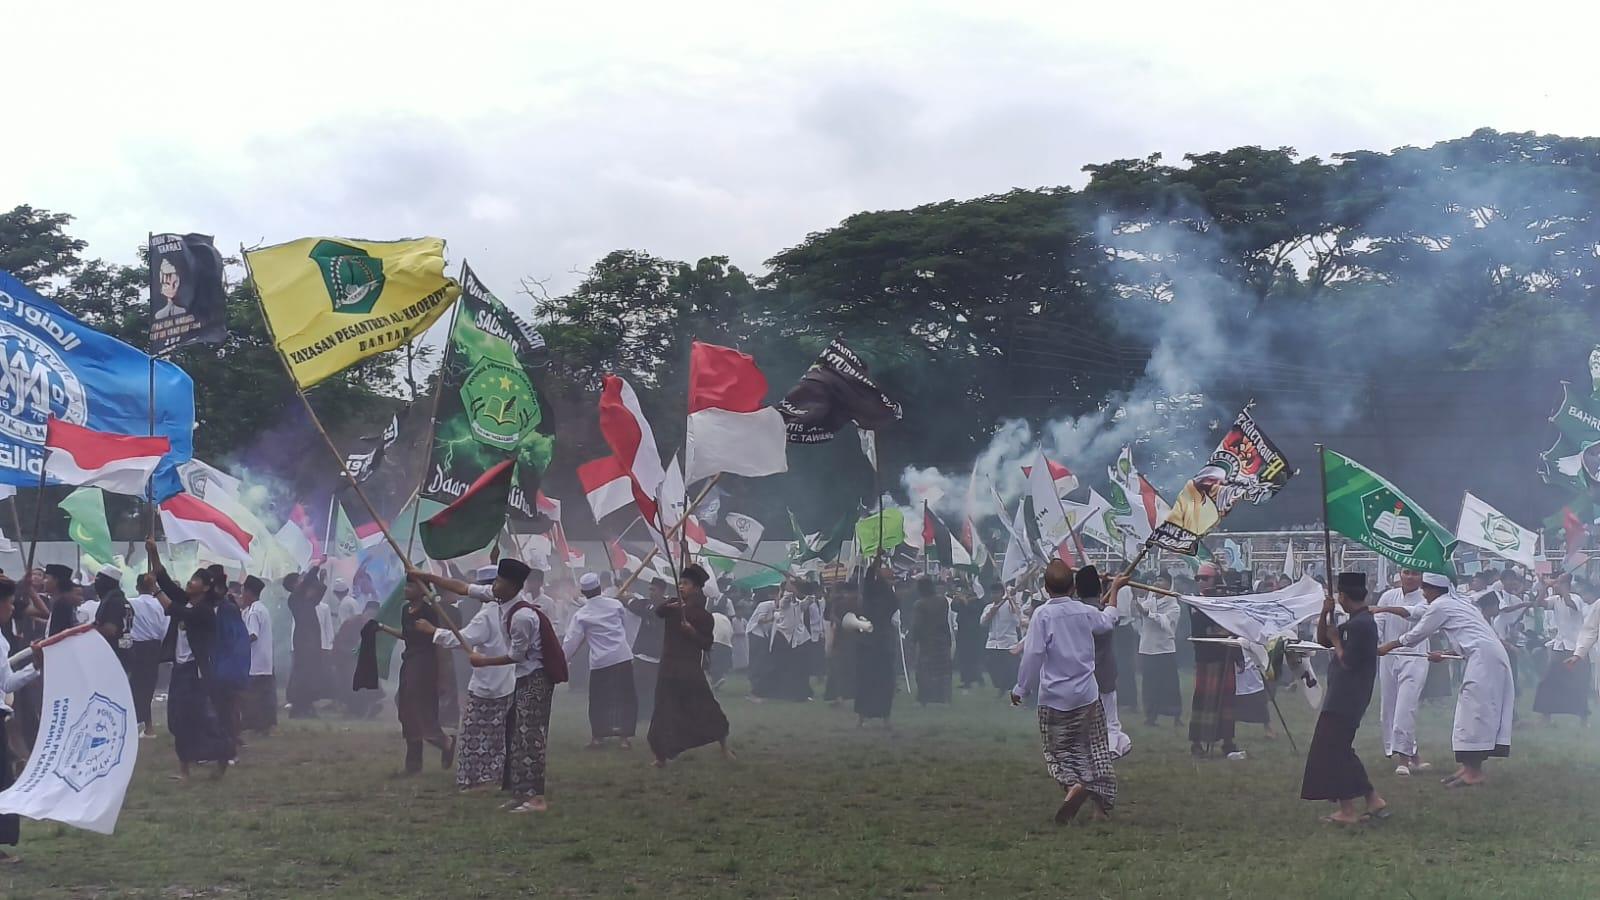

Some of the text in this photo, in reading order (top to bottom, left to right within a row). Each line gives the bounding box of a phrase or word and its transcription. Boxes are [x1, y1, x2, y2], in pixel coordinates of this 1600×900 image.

[289, 334, 337, 364] YAYASAN
[334, 316, 391, 343] PESANTREN
[1402, 556, 1433, 568] HUDA
[43, 700, 61, 753] MIFTAHUL
[57, 698, 69, 741] PONDOK
